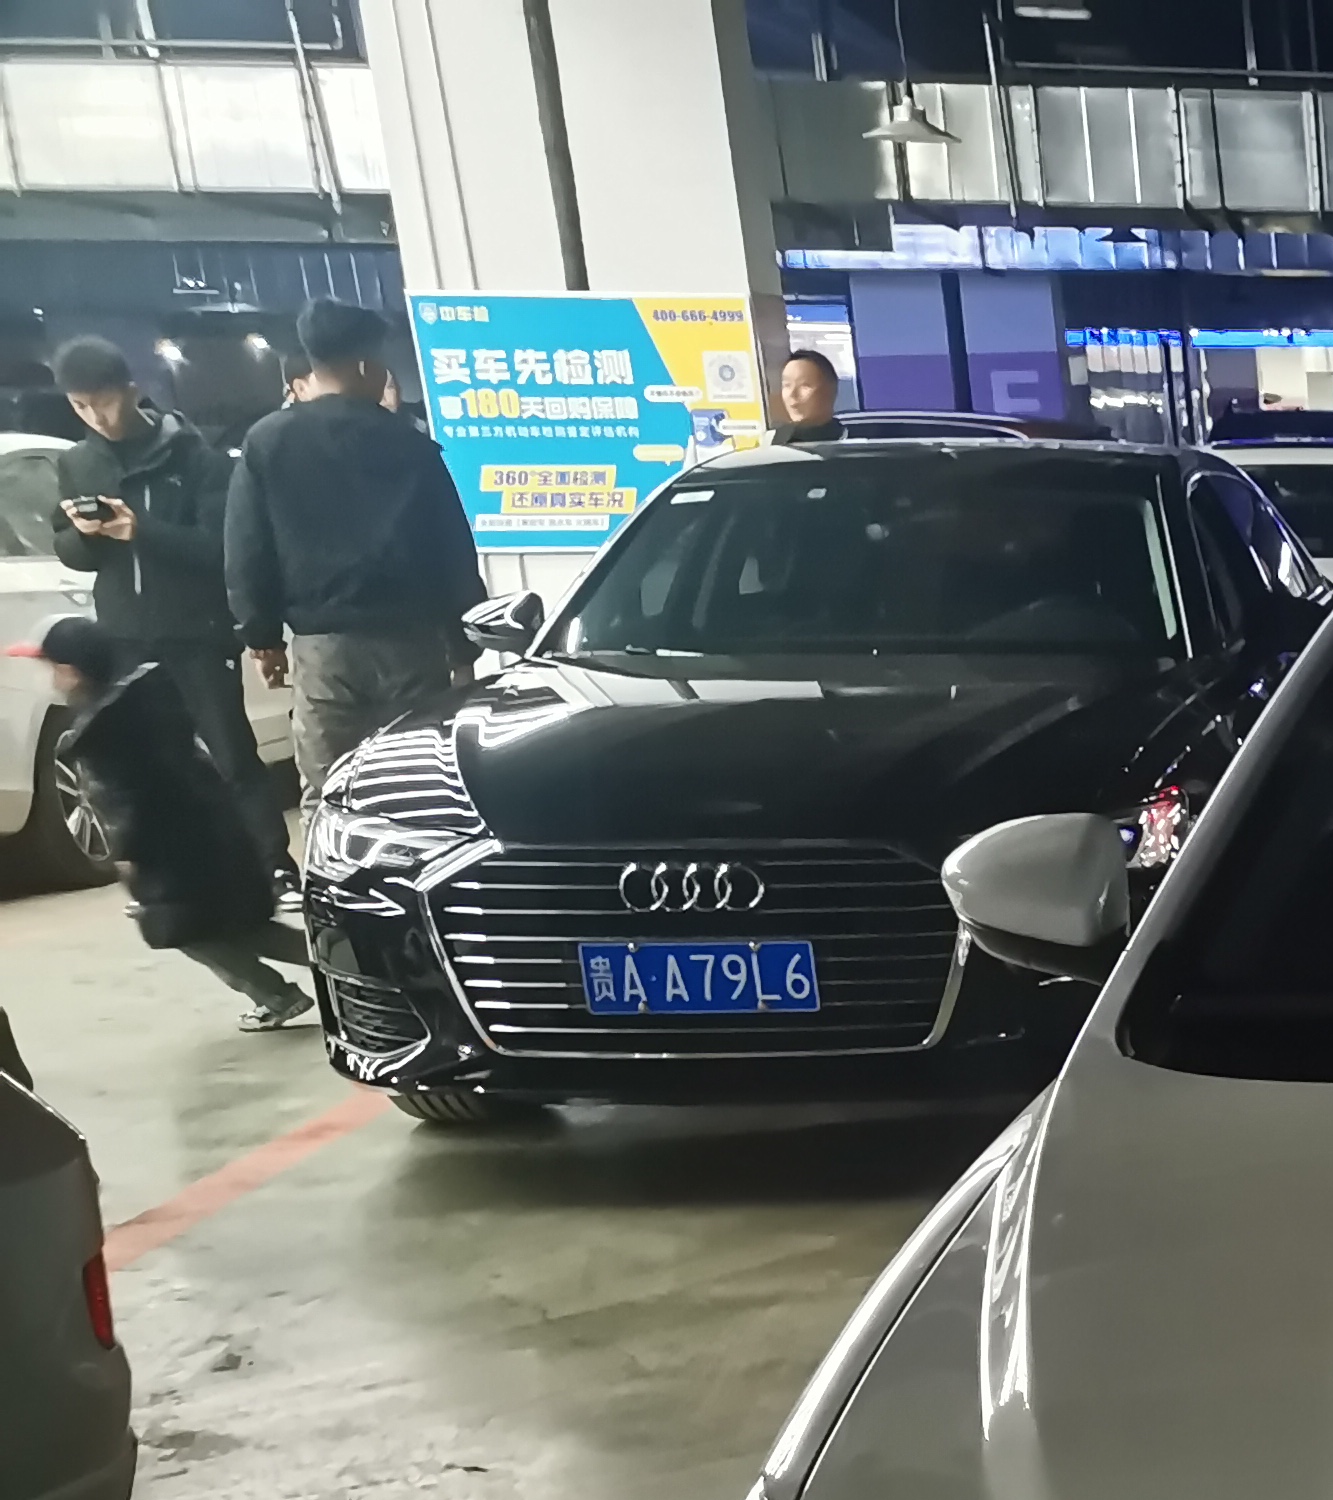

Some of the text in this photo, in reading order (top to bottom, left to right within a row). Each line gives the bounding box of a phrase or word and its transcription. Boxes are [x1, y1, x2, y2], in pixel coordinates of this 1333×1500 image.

[652, 309, 745, 322] 400-666-4999
[430, 348, 635, 385] 买车先检测
[511, 491, 625, 508] 还原真实车况
